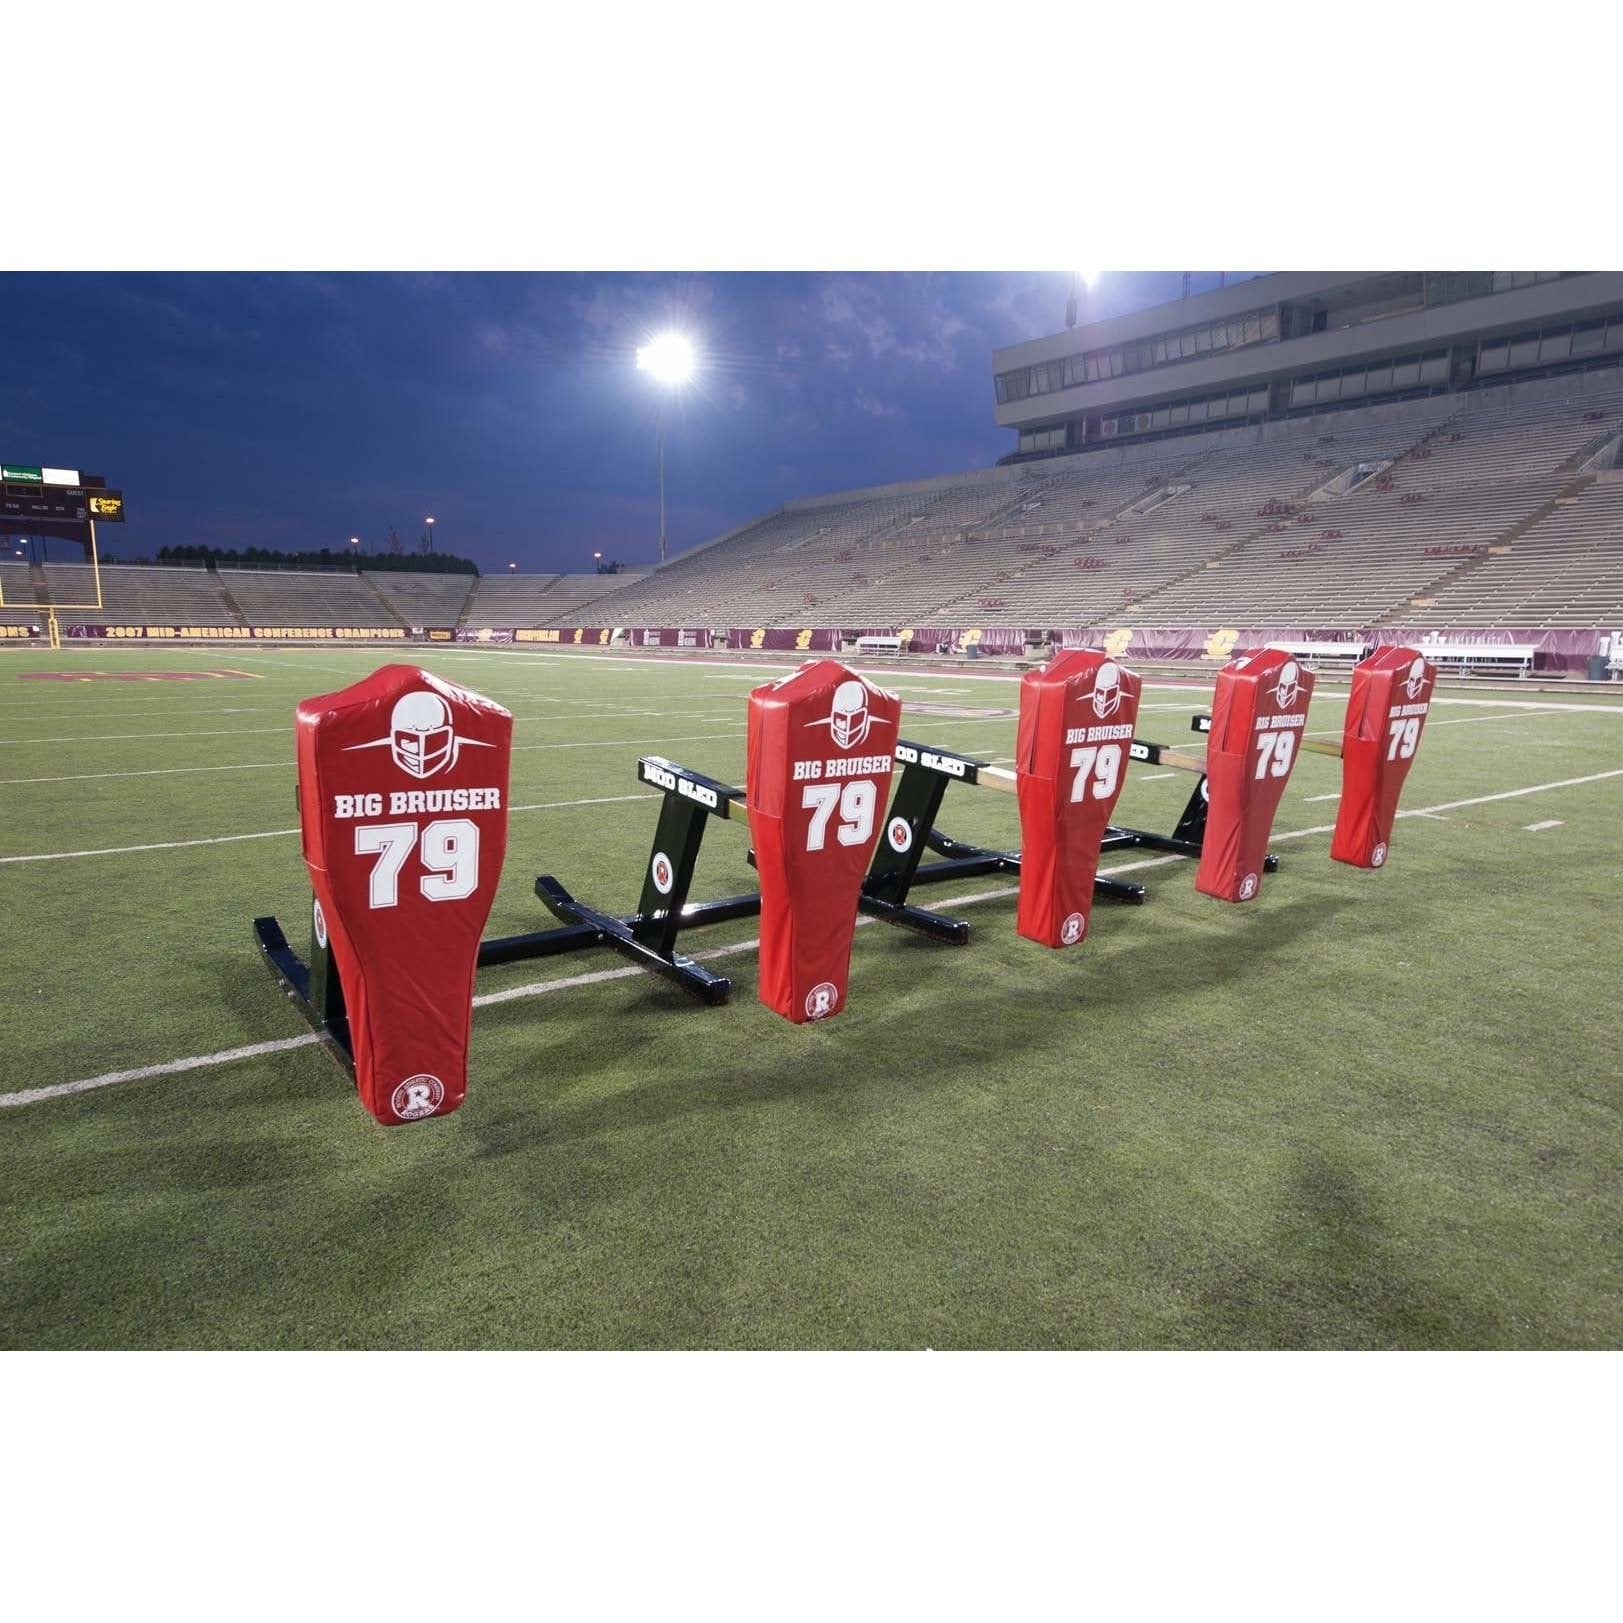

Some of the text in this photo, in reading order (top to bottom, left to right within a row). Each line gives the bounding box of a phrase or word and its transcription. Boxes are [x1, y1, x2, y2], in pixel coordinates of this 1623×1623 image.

[105, 626, 405, 638] 2007 MID-AMERICAN CONFERENCE CHAMPIONS
[1065, 724, 1134, 745] BIG BRUISER
[1387, 717, 1420, 761] 79
[793, 755, 892, 780] BIG BRUISER
[895, 745, 965, 777] OD SLED
[1070, 744, 1122, 803] 79
[1255, 731, 1295, 780] 79
[334, 787, 501, 818] BIG BRUISER
[644, 763, 718, 808] MOD SLED
[802, 779, 877, 852] 79
[355, 818, 480, 909] 79
[406, 1084, 434, 1111] R
